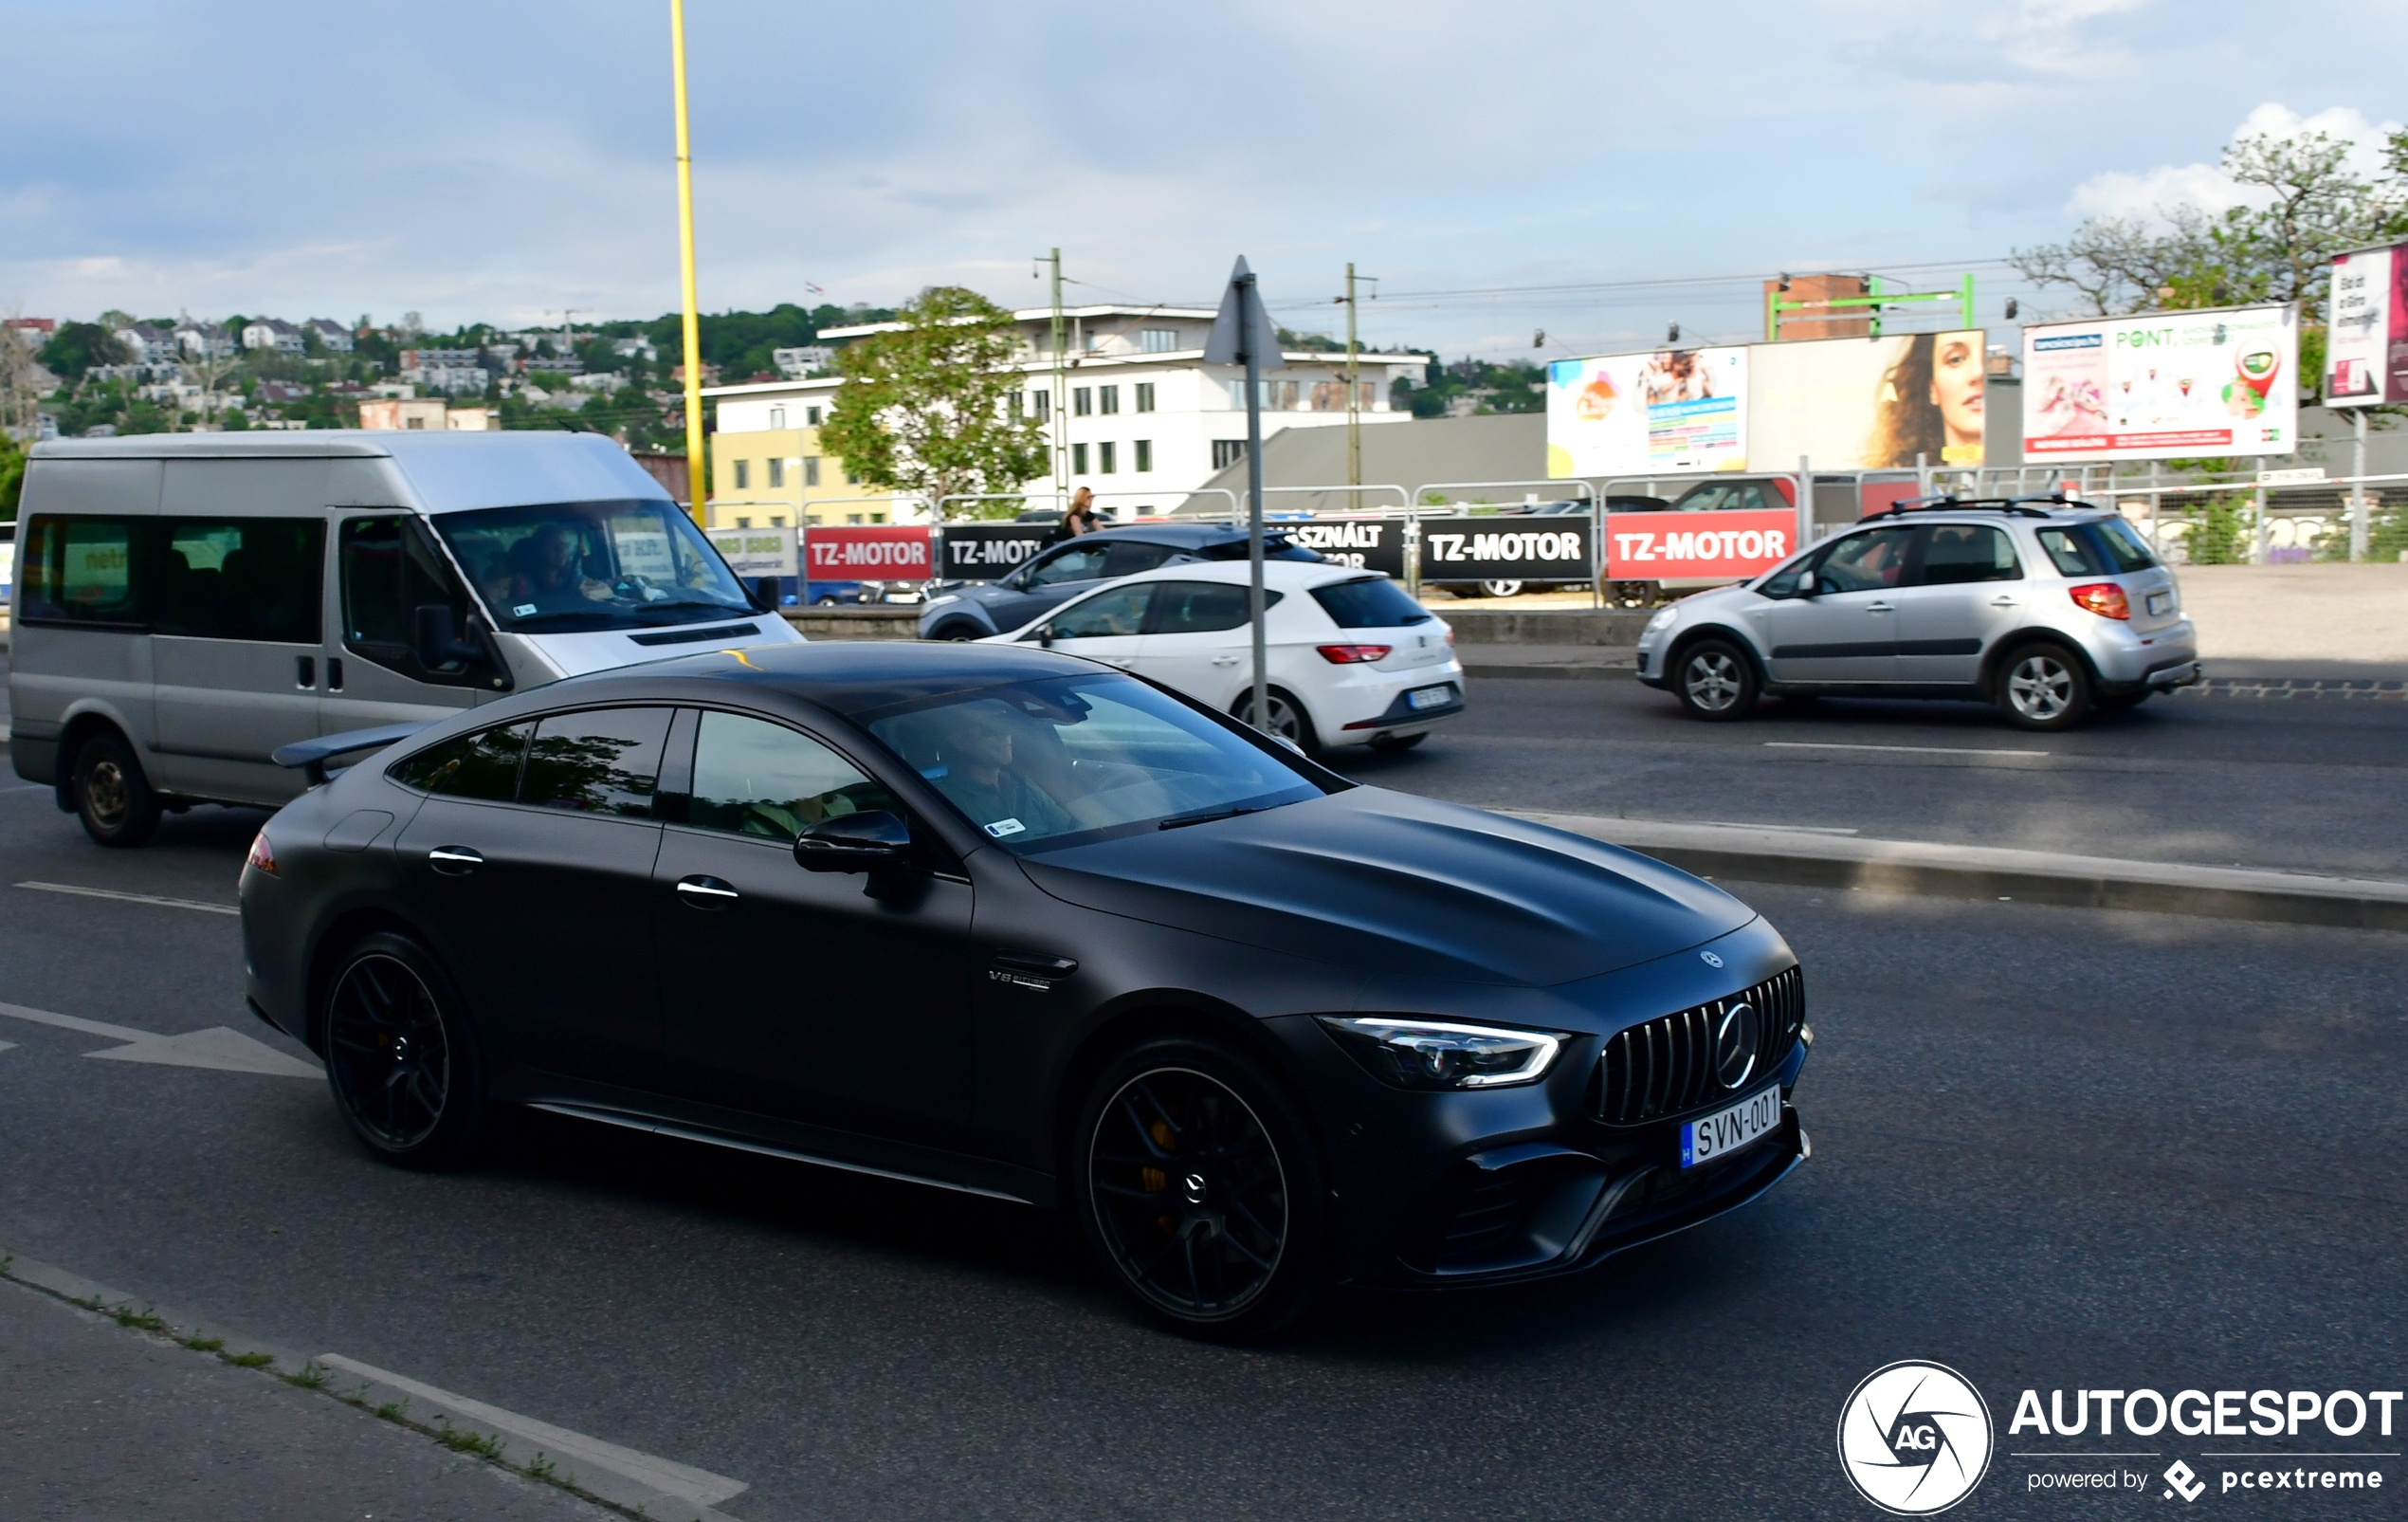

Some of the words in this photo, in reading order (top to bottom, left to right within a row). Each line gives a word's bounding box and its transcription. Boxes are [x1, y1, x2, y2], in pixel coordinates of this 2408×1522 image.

[811, 541, 926, 566] TZ-MOTOR
[949, 540, 1041, 565] TZ-MOT
[1428, 532, 1581, 561] TZ-MOTOR
[1614, 529, 1786, 561] TZ-MOTOR
[989, 970, 1012, 982] V8
[1698, 1090, 1778, 1156] SVN-001
[1682, 1147, 1690, 1162] H
